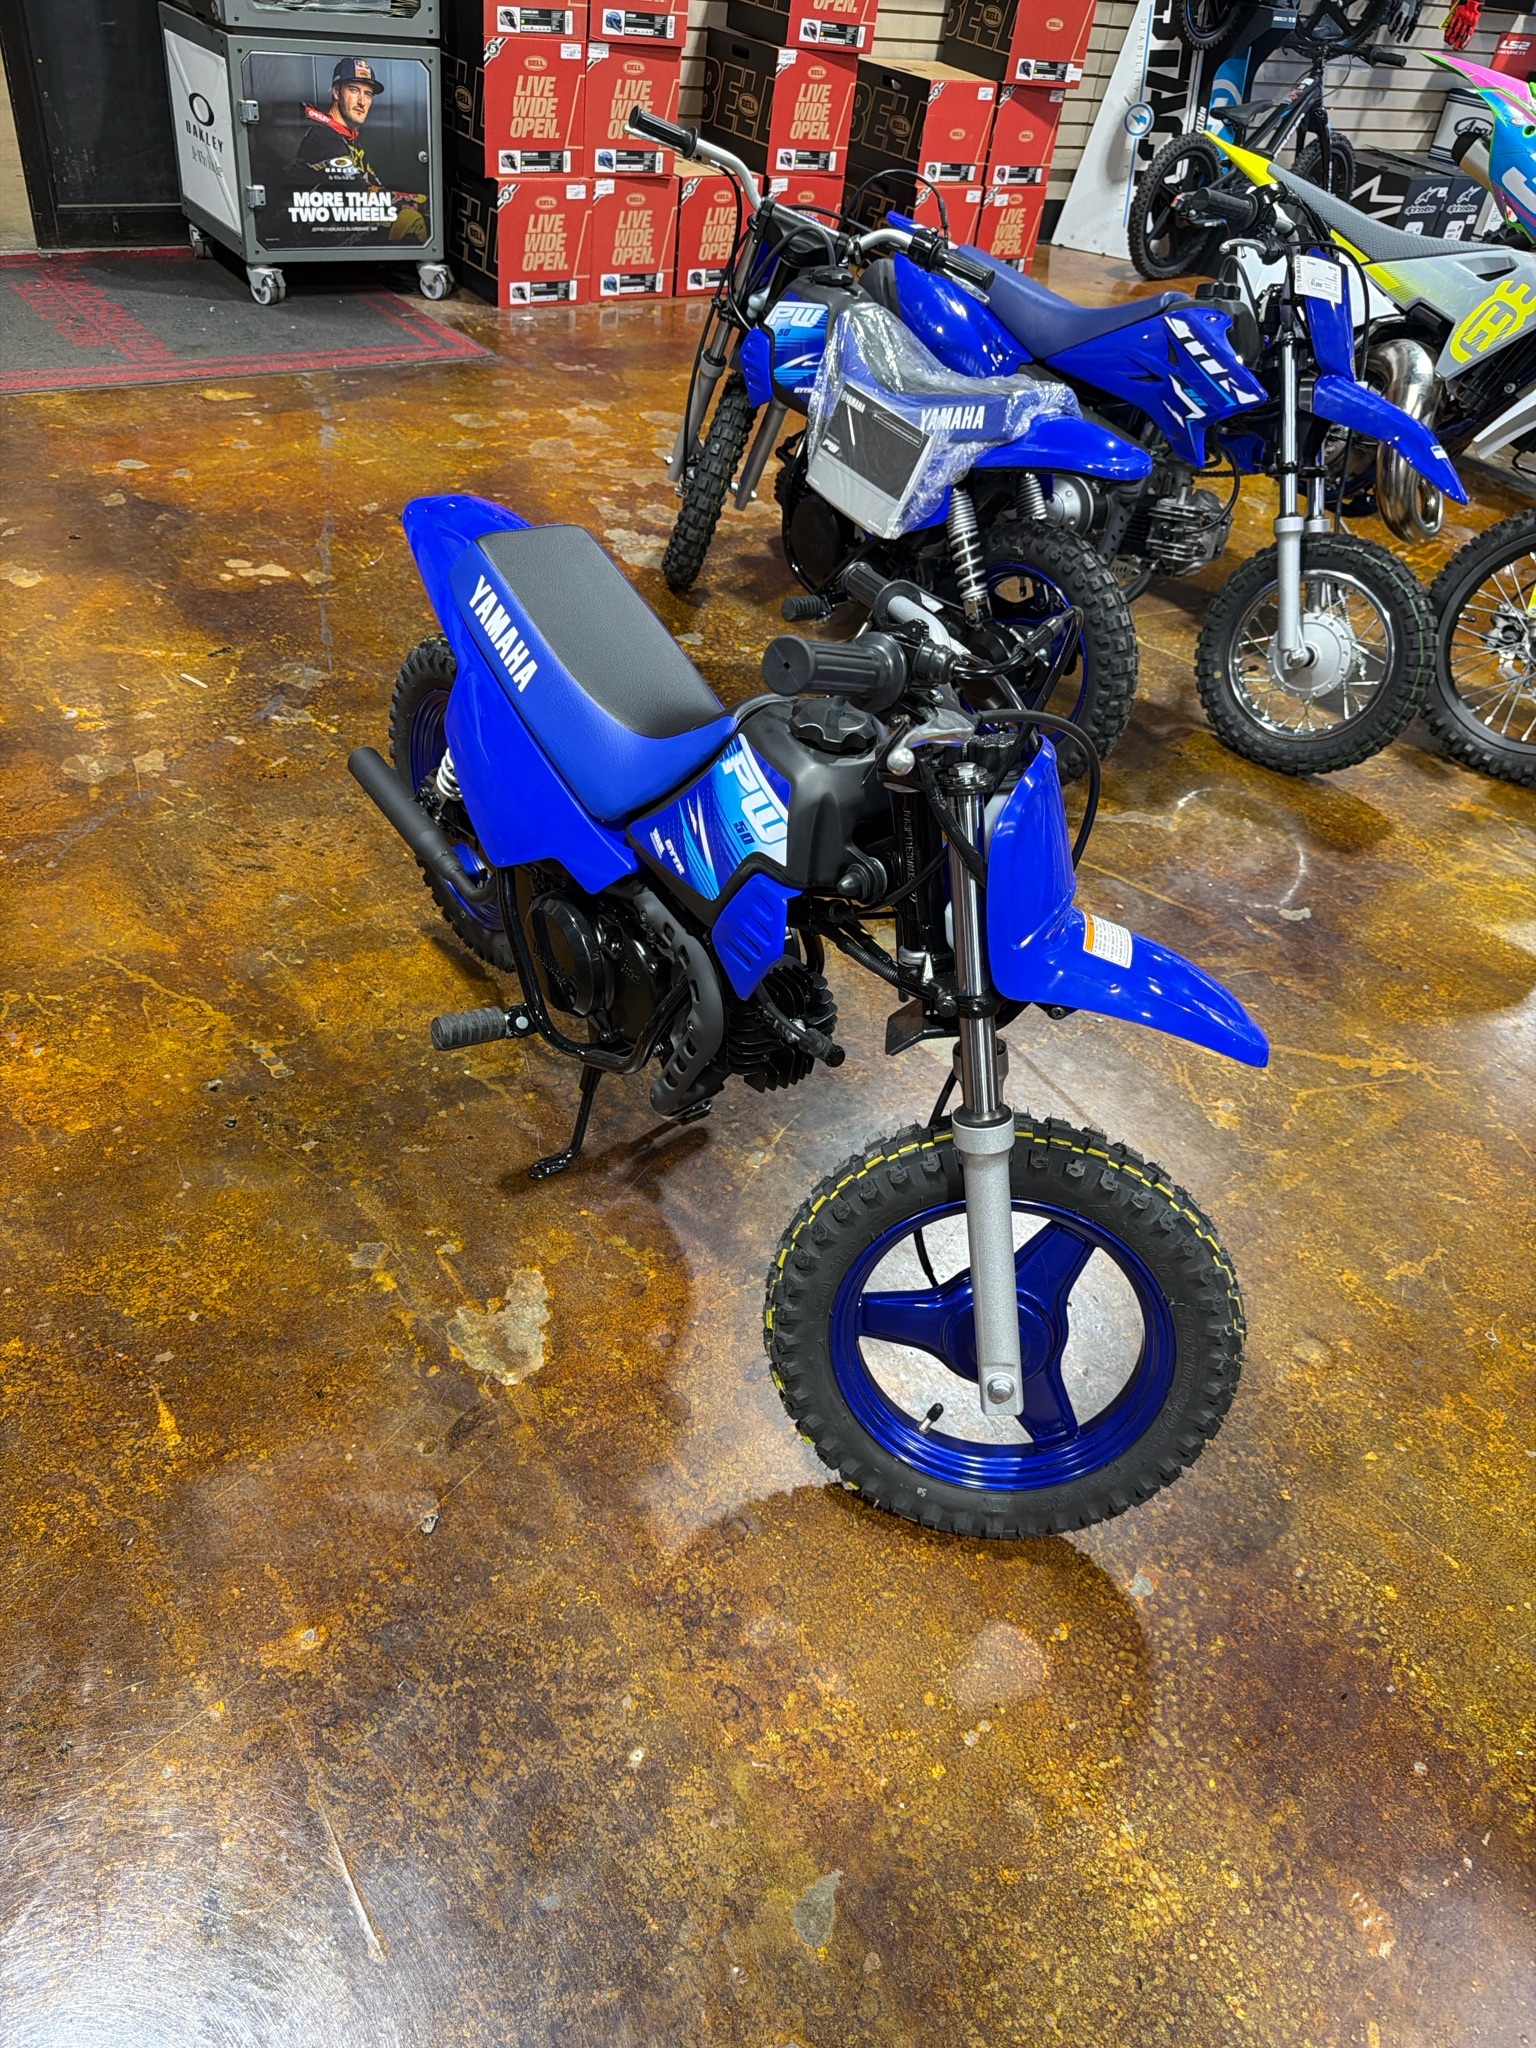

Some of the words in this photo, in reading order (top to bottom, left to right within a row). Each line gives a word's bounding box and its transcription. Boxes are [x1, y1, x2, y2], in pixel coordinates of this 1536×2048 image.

[1499, 40, 1531, 50] LS2
[515, 75, 557, 97] LIVE
[613, 79, 653, 100] LIVE
[797, 83, 832, 103] LIVE
[512, 96, 559, 118] WIDE
[794, 102, 832, 122] WIDE
[185, 120, 224, 153] OAKLEY
[509, 117, 561, 139] OPEN.
[789, 121, 831, 140] OPEN.
[292, 191, 344, 207] MORE
[345, 191, 391, 207] THAN
[287, 206, 329, 223] TWO
[331, 206, 398, 222] WHEELS
[527, 214, 566, 233] LIVE
[617, 210, 653, 229] LIVE
[704, 206, 737, 226] LIVE
[999, 207, 1027, 225] LIVE
[614, 228, 655, 247] WIDE
[994, 223, 1026, 240] WIDE
[524, 233, 568, 253] WIDE
[521, 252, 569, 272] OPEN.
[611, 246, 656, 266] OPEN.
[777, 328, 791, 337] 50
[844, 393, 866, 414] YAMAHA
[920, 405, 986, 431] YAMAHA
[468, 574, 538, 693] YAMAHA
[732, 820, 756, 846] 50
